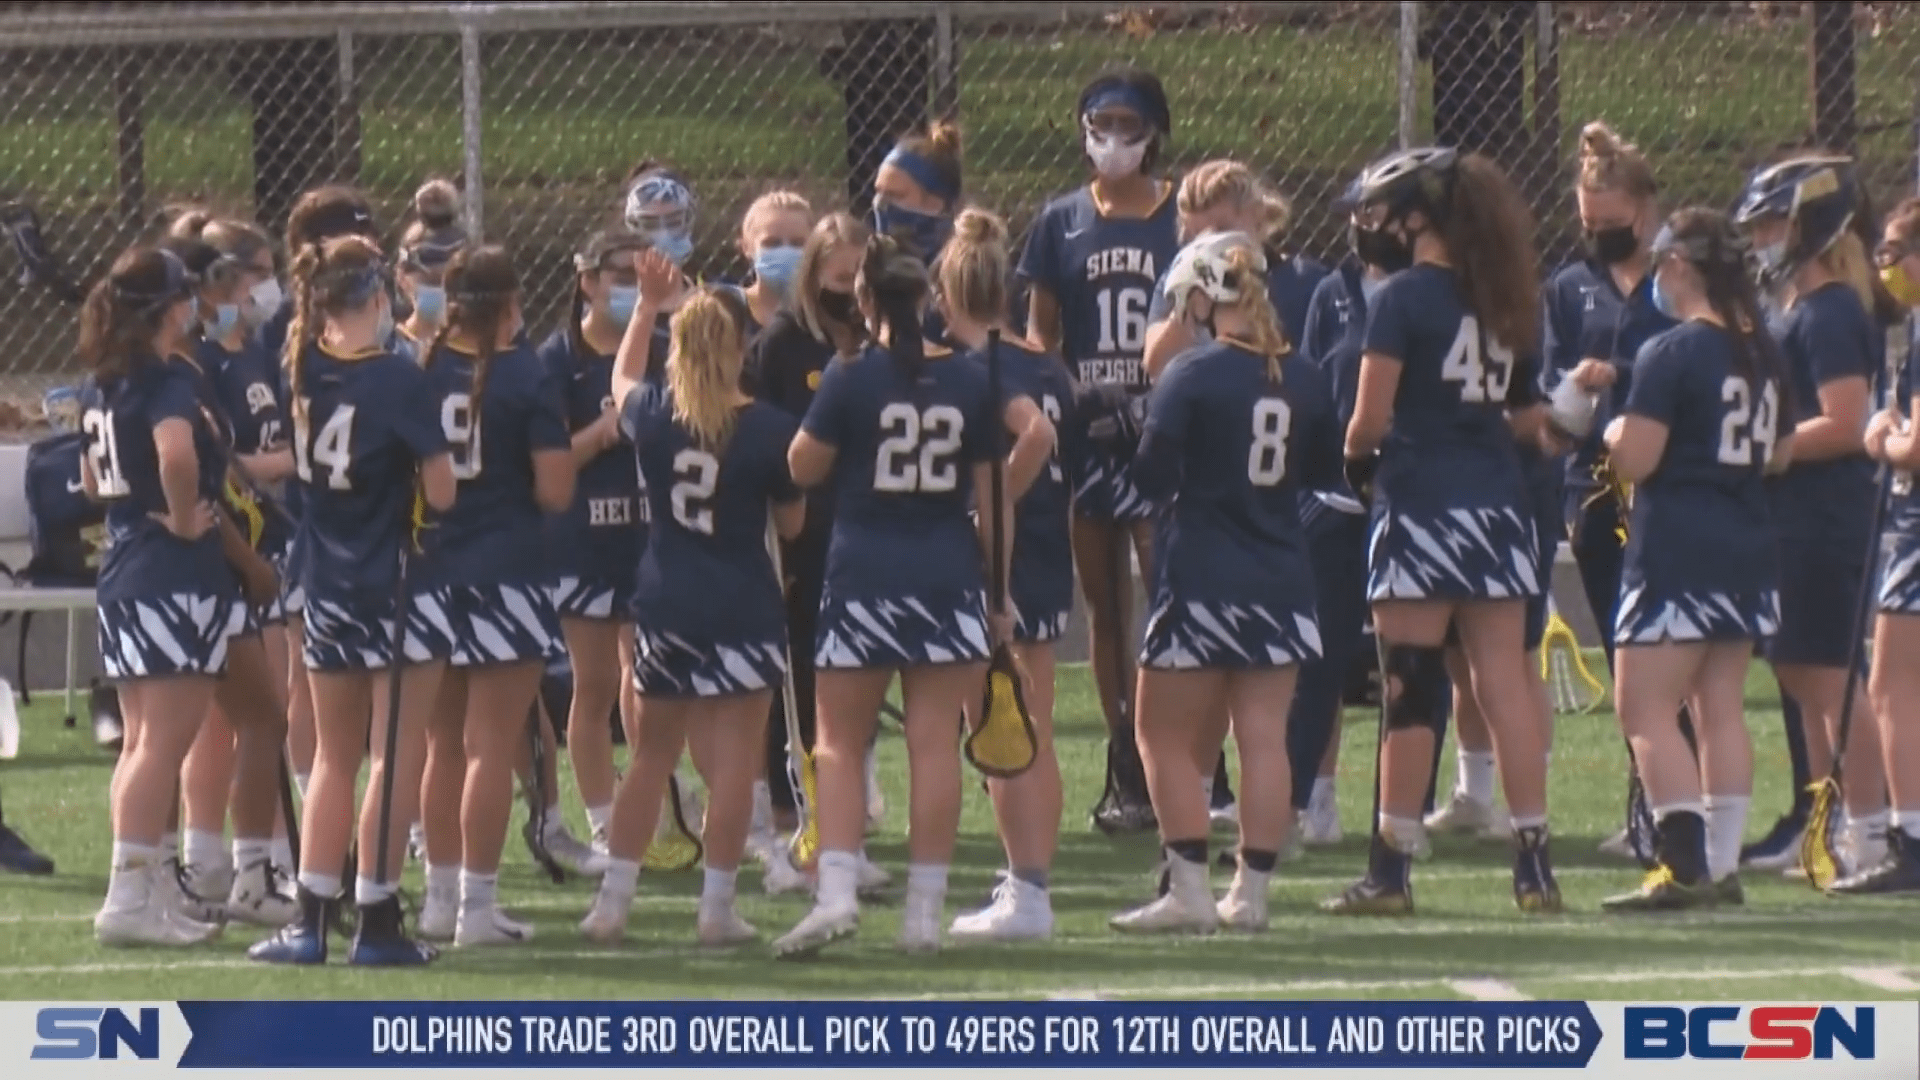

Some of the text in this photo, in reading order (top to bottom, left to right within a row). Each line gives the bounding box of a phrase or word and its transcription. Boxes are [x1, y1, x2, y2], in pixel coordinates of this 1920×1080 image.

[1086, 246, 1156, 283] SIENA
[1096, 287, 1148, 352] 16
[1078, 357, 1152, 385] HEIGH
[83, 409, 131, 496] 21
[292, 396, 356, 490] 14
[873, 402, 965, 492] 22
[1248, 397, 1292, 487] 8
[1717, 375, 1779, 466] 24
[670, 448, 719, 535] 2
